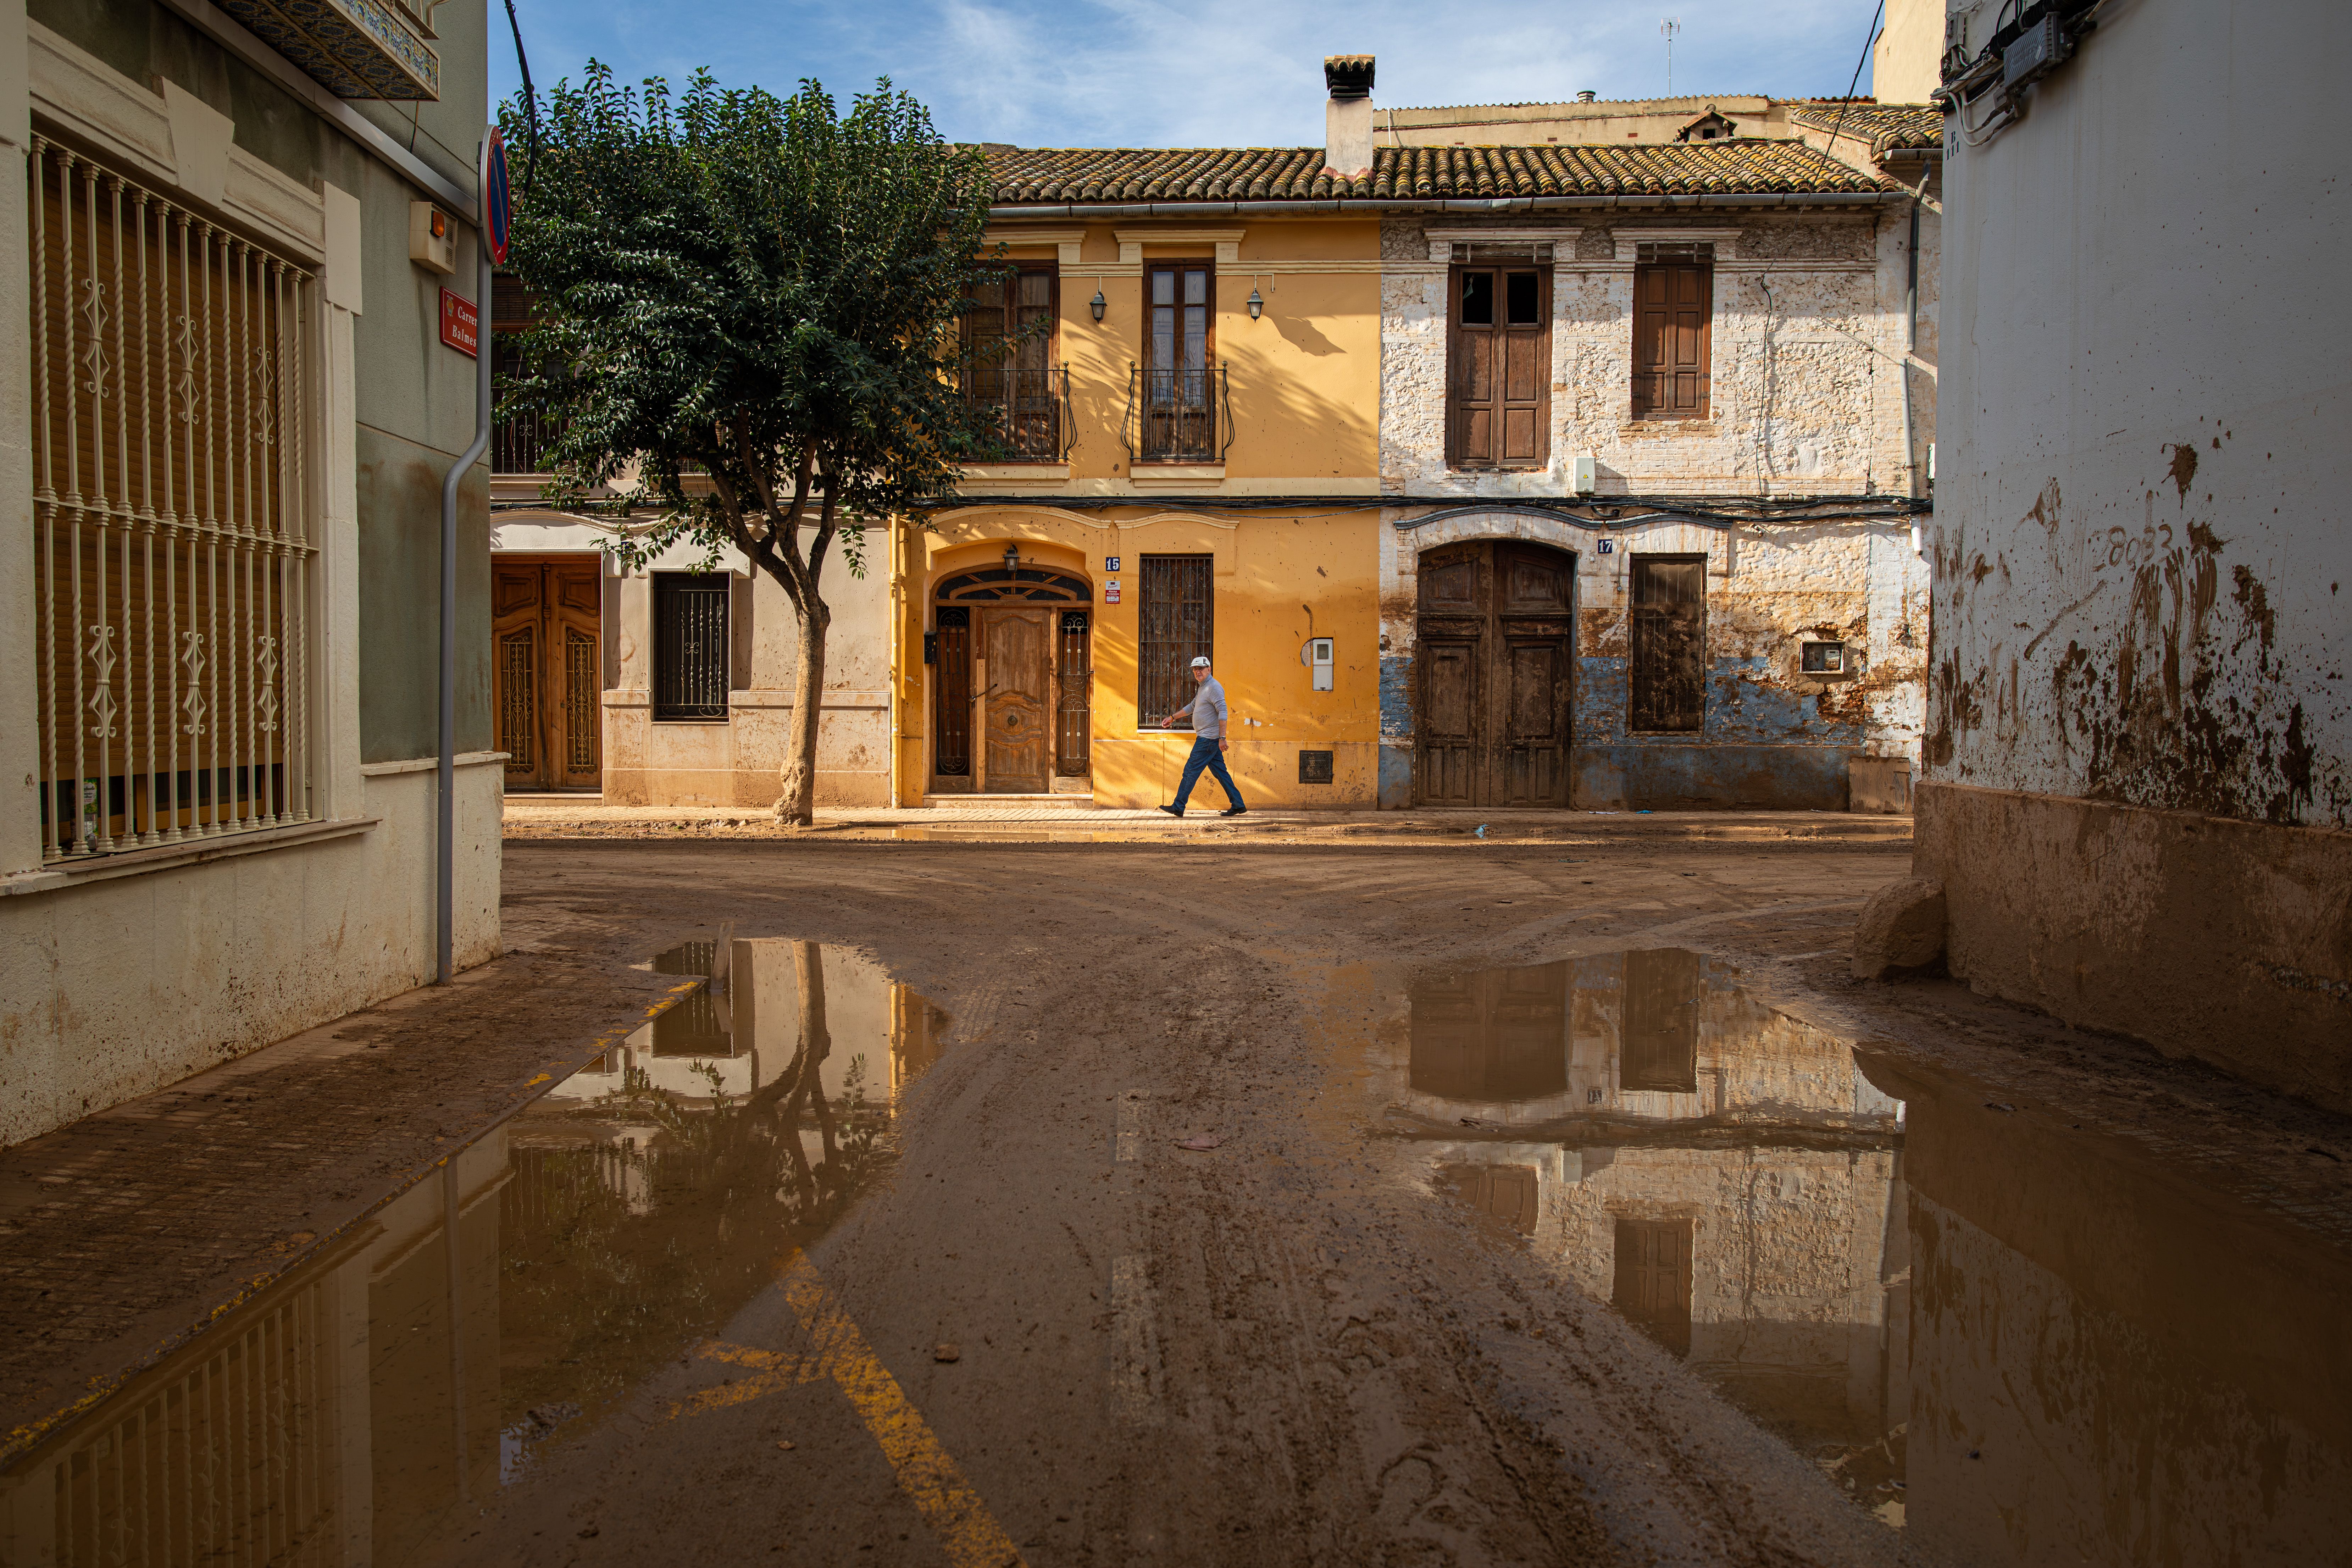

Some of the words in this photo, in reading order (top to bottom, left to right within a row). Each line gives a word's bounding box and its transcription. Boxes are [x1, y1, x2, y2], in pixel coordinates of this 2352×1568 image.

[1951, 131, 1956, 145] B
[1946, 141, 1959, 161] 111
[458, 306, 477, 327] Carrer
[452, 325, 476, 347] Balmes
[1599, 541, 1612, 552] 17
[1106, 558, 1119, 570] 15
